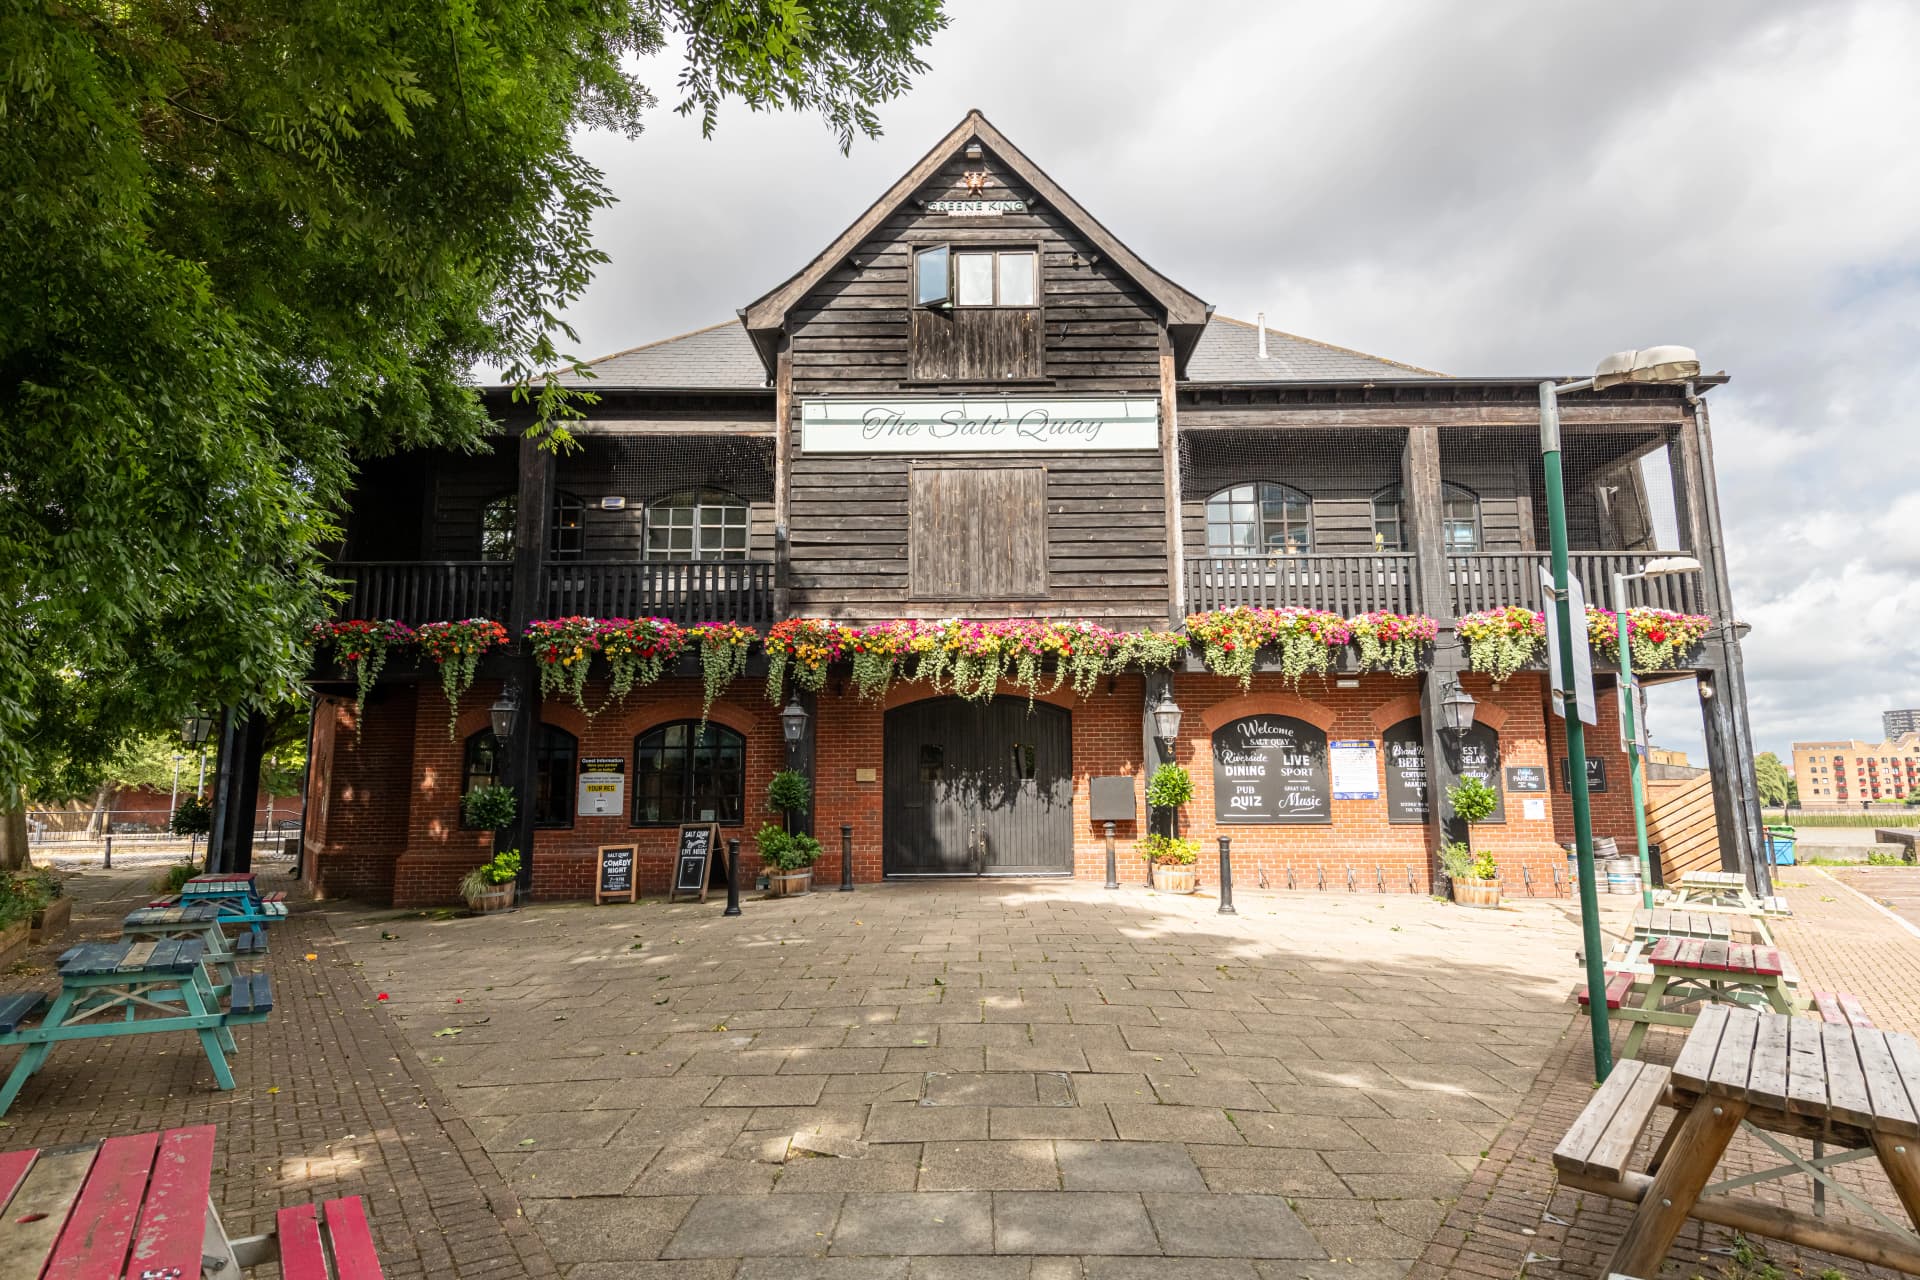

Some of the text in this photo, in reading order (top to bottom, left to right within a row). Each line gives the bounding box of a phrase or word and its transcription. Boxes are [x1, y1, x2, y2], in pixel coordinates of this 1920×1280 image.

[928, 201, 1024, 211] GREENE KING
[862, 408, 1104, 442] The Salt Quay
[1237, 720, 1294, 737] Welcome
[1249, 738, 1290, 748] SALT QUAY
[1462, 746, 1478, 755] EST
[1221, 749, 1268, 764] Riverside
[1283, 755, 1310, 766] LIVE
[1225, 765, 1266, 777] DINING
[1280, 767, 1313, 777] SPORT
[1236, 786, 1255, 794] PUB
[1230, 795, 1262, 811] QUIZ
[1278, 792, 1322, 813] Music
[603, 858, 632, 868] COMEDY
[608, 866, 627, 874] NIGHT
